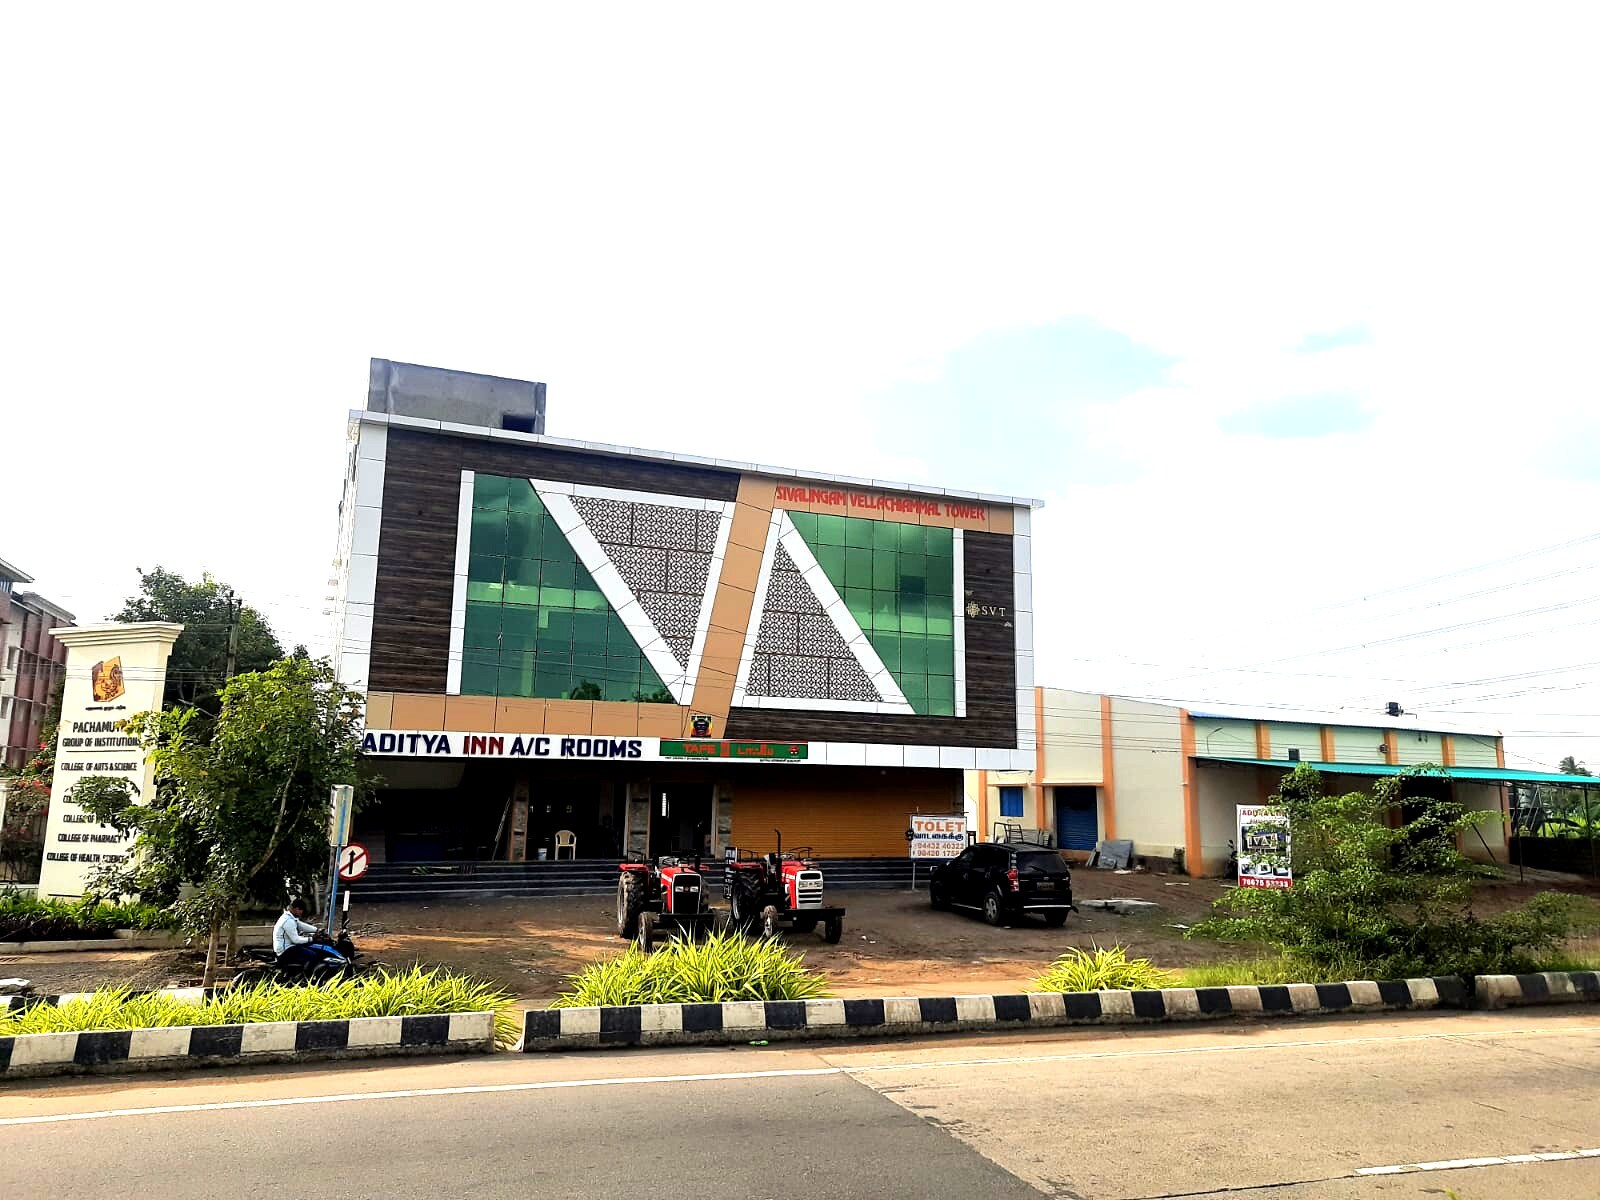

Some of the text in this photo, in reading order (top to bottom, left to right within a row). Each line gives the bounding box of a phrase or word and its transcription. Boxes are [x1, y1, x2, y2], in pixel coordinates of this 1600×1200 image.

[776, 486, 846, 505] SIVALINGAM
[945, 504, 985, 521] TOWER
[62, 737, 83, 747] GROUP
[84, 737, 94, 747] OF
[363, 732, 642, 758] ADITYA INN A/C ROOMS
[61, 762, 84, 771] COLLEGE
[86, 762, 94, 771] OF
[94, 762, 108, 771] ARTS
[114, 762, 137, 771] SCIENCE
[58, 833, 82, 842] COLLEGE
[82, 834, 89, 842] OF
[47, 852, 70, 861] COLLEGE
[70, 853, 78, 861] OF
[79, 854, 100, 862] HEALTH
